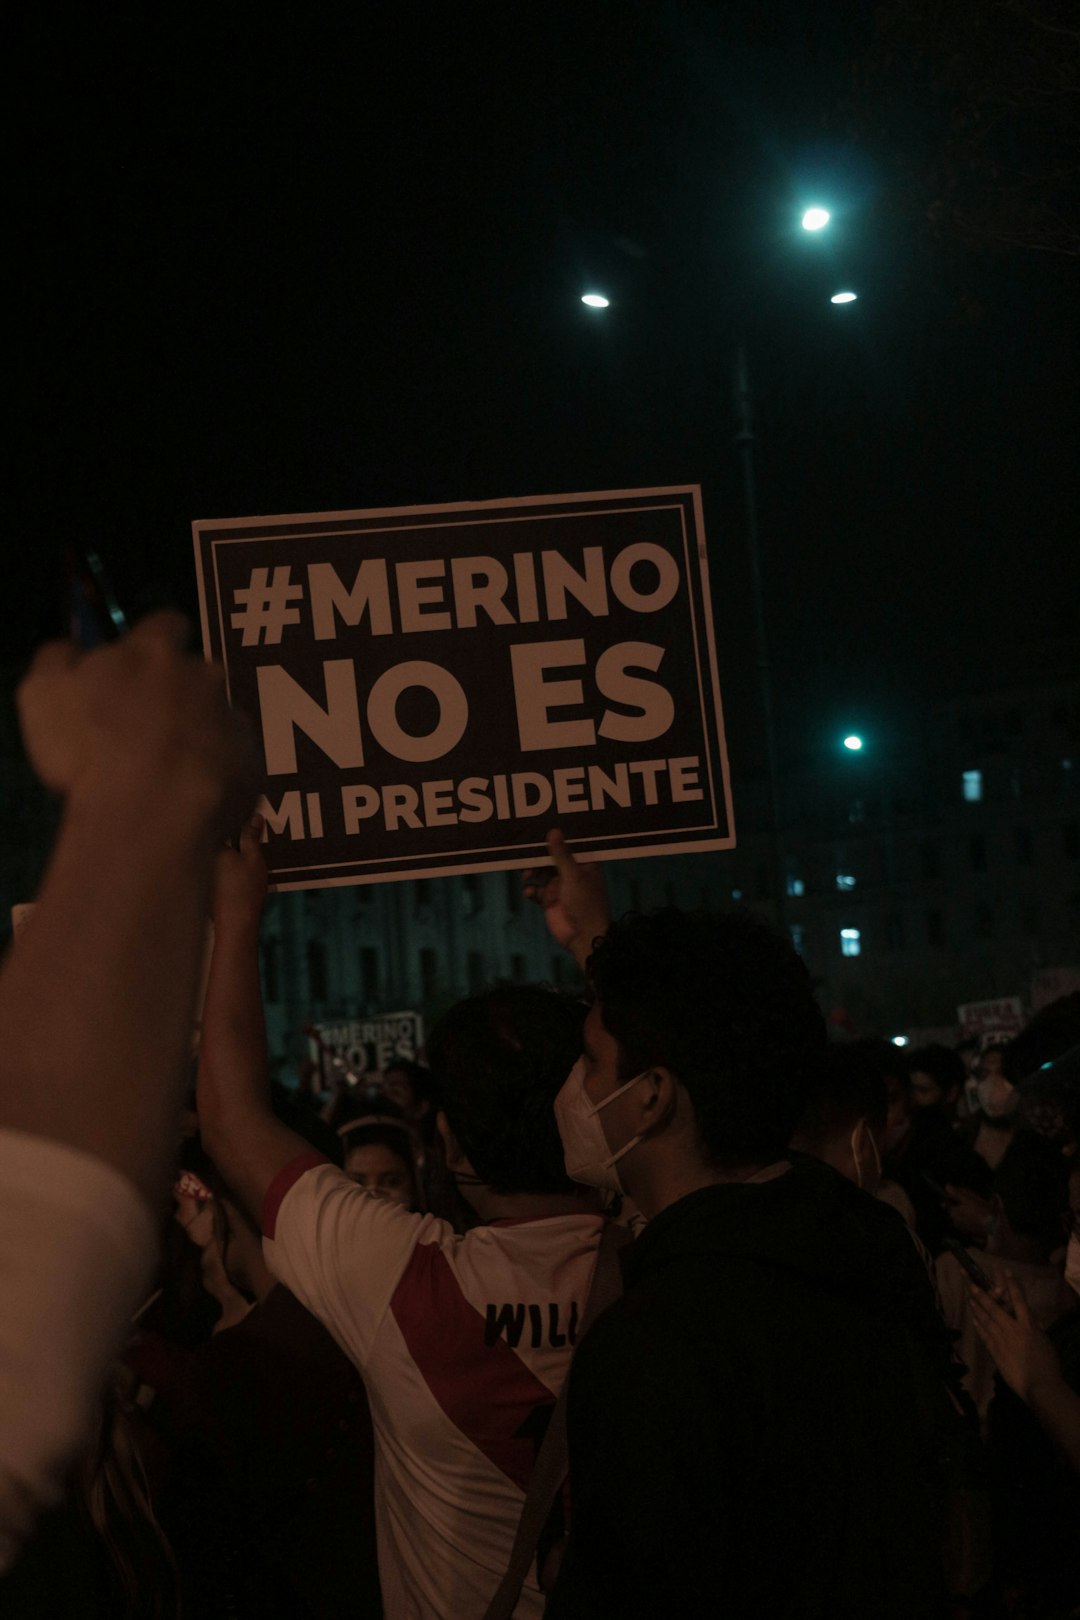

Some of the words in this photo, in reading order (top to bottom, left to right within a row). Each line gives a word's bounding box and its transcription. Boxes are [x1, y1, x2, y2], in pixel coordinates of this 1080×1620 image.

[230, 542, 680, 647] #MERINO
[255, 657, 469, 776] NO
[509, 638, 676, 752] ES
[255, 789, 324, 843] MI
[340, 755, 704, 836] PRESIDENTE
